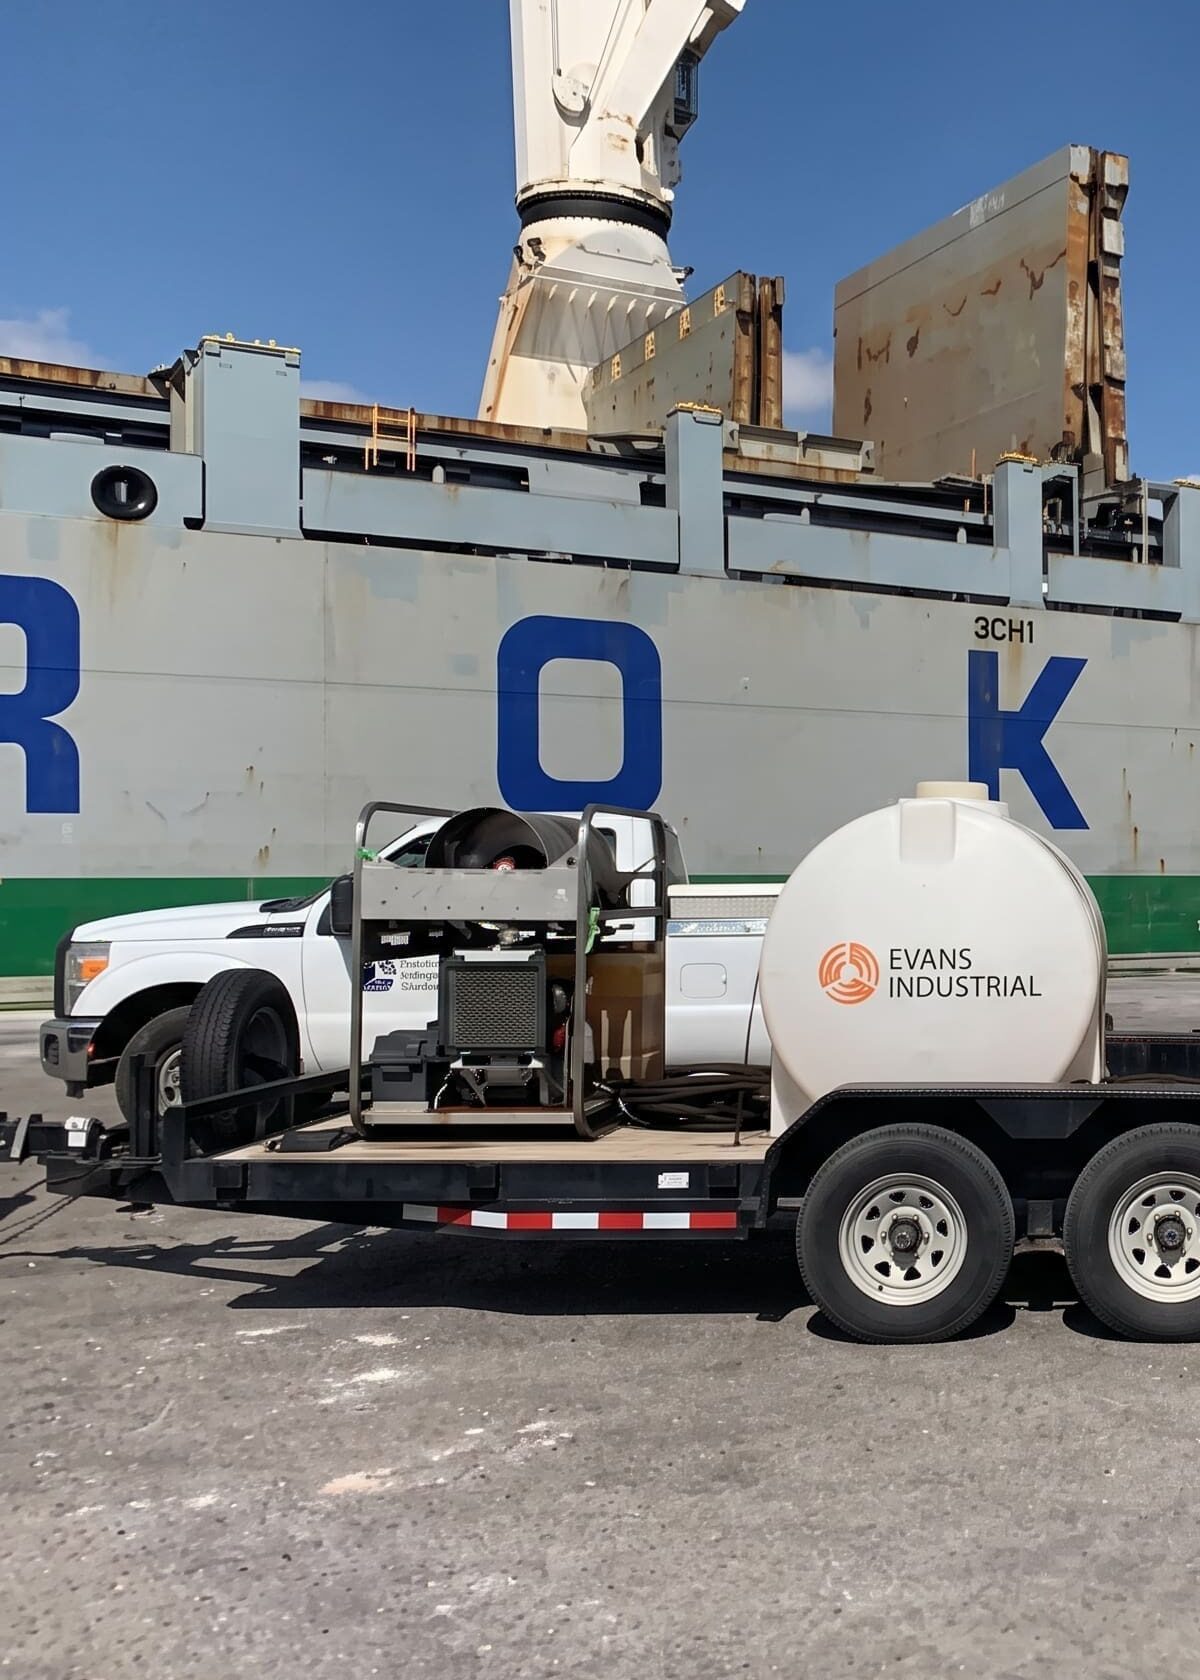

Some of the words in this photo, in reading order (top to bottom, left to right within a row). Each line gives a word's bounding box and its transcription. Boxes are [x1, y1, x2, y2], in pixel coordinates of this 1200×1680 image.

[974, 616, 1034, 644] 3CH1
[968, 650, 1090, 830] K
[890, 948, 972, 970] EVANS
[889, 975, 1042, 998] INDUSTRIAL
